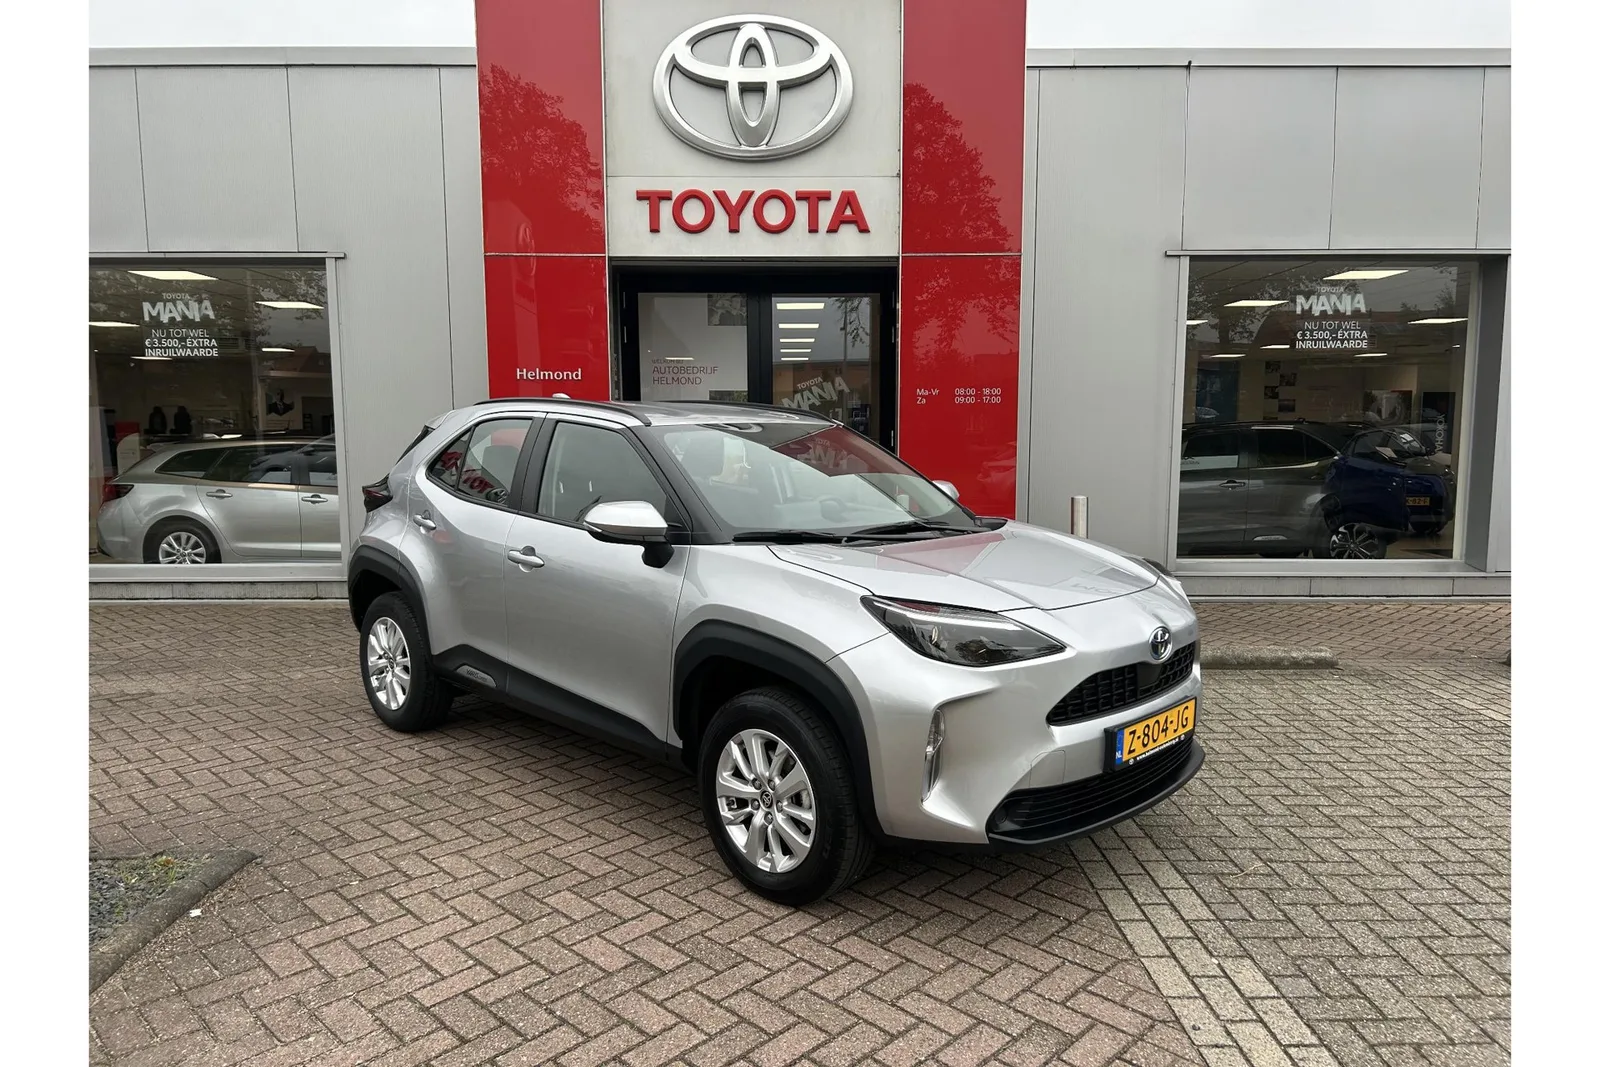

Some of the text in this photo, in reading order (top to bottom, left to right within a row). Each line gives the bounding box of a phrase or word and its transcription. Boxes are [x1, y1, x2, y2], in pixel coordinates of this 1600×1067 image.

[636, 189, 871, 234] TOYOTA
[1296, 293, 1367, 316] MANIA
[142, 299, 215, 323] MANIA
[1304, 321, 1361, 330] NU TOT WEL
[151, 328, 210, 338] NU TOT WEL
[1295, 340, 1368, 349] INRUILWAARDE
[145, 348, 219, 357] INRUILWAARDE
[516, 367, 582, 380] Helmond
[652, 366, 718, 375] AUTOBEDRIJF
[652, 376, 702, 385] HELMOND
[797, 376, 823, 390] TOYOTA
[916, 388, 940, 396] Ma-Vr
[954, 388, 976, 396] 08:00
[916, 396, 926, 405] Za
[954, 396, 976, 404] 09:00
[983, 396, 1002, 404] 17:00
[1127, 705, 1189, 756] Z-804-JG
[1115, 750, 1122, 759] NL
